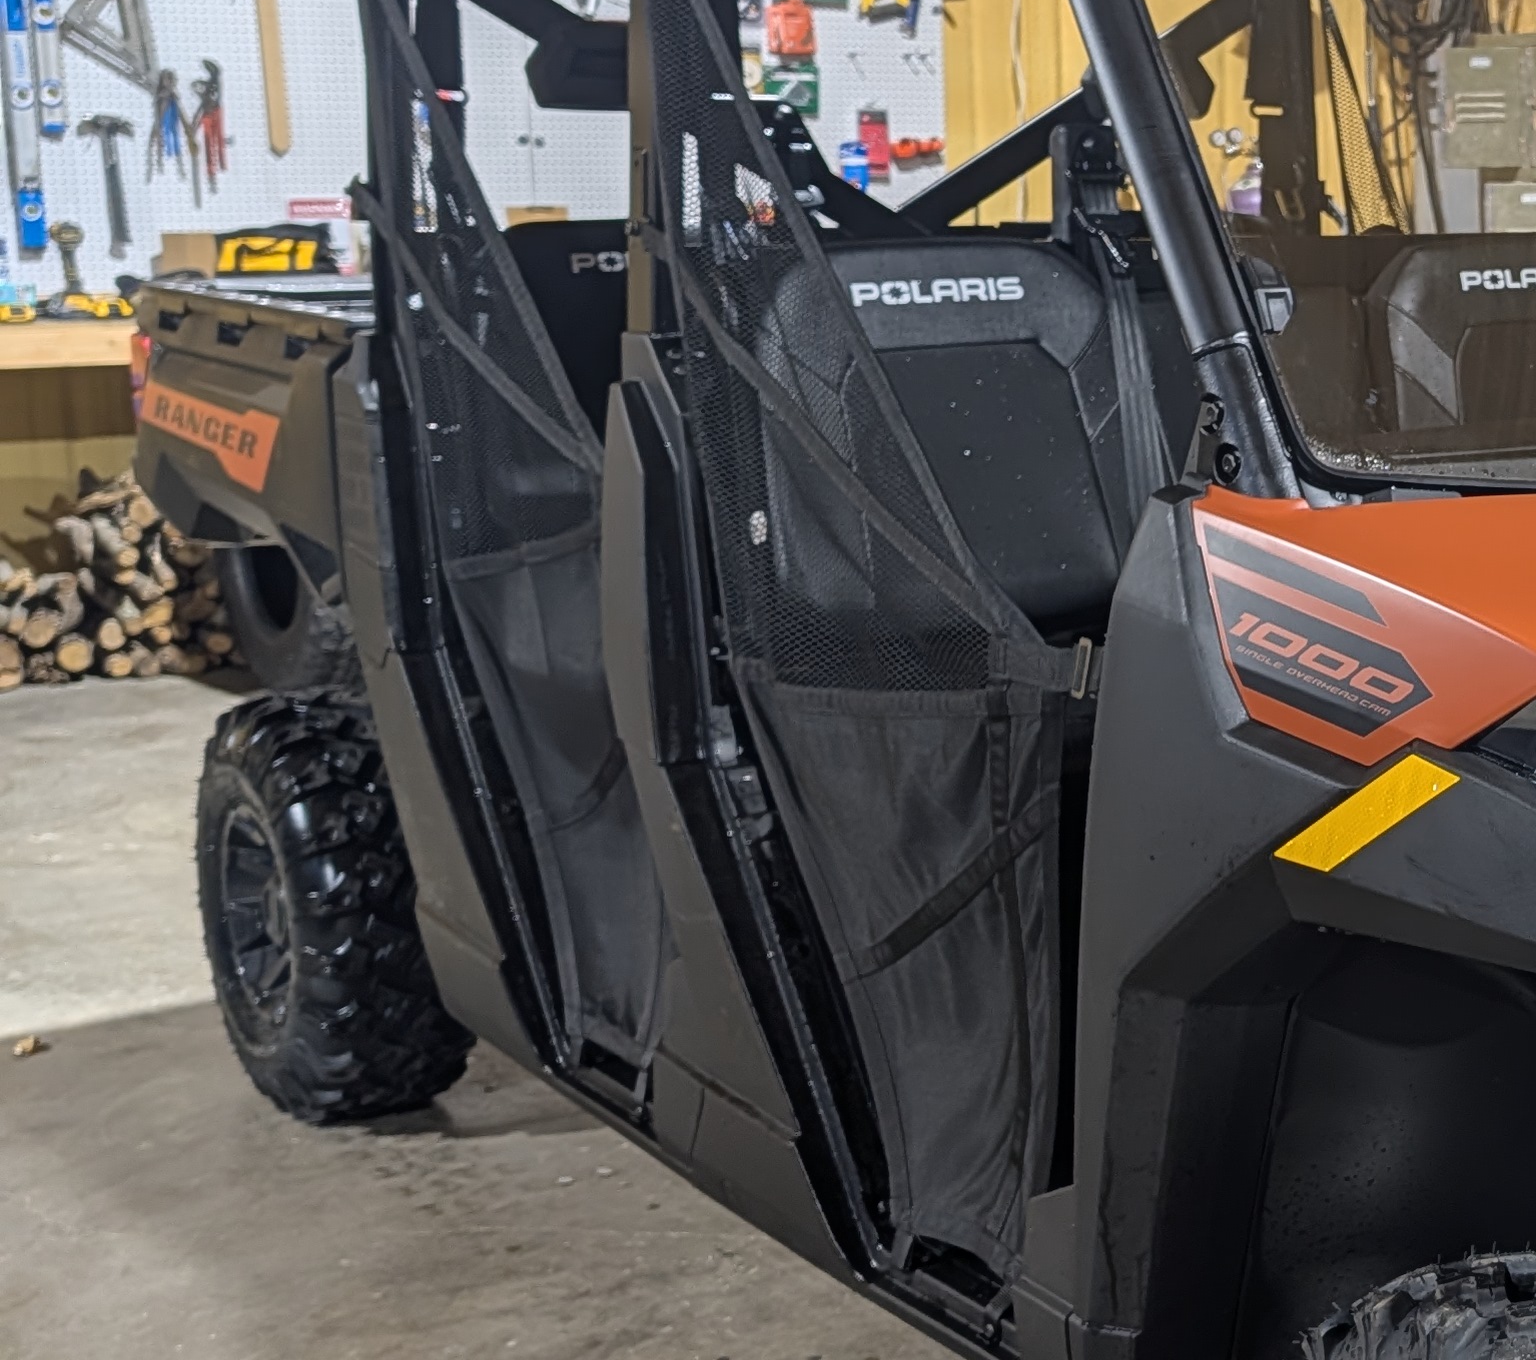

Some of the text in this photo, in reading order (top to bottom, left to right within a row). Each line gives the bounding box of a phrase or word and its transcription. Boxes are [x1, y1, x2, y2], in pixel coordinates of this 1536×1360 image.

[850, 276, 1024, 307] POLARIS
[154, 394, 258, 459] RANGER
[1228, 612, 1415, 705] 1000
[1235, 644, 1392, 718] SINGLE OVERHEAD CAM
